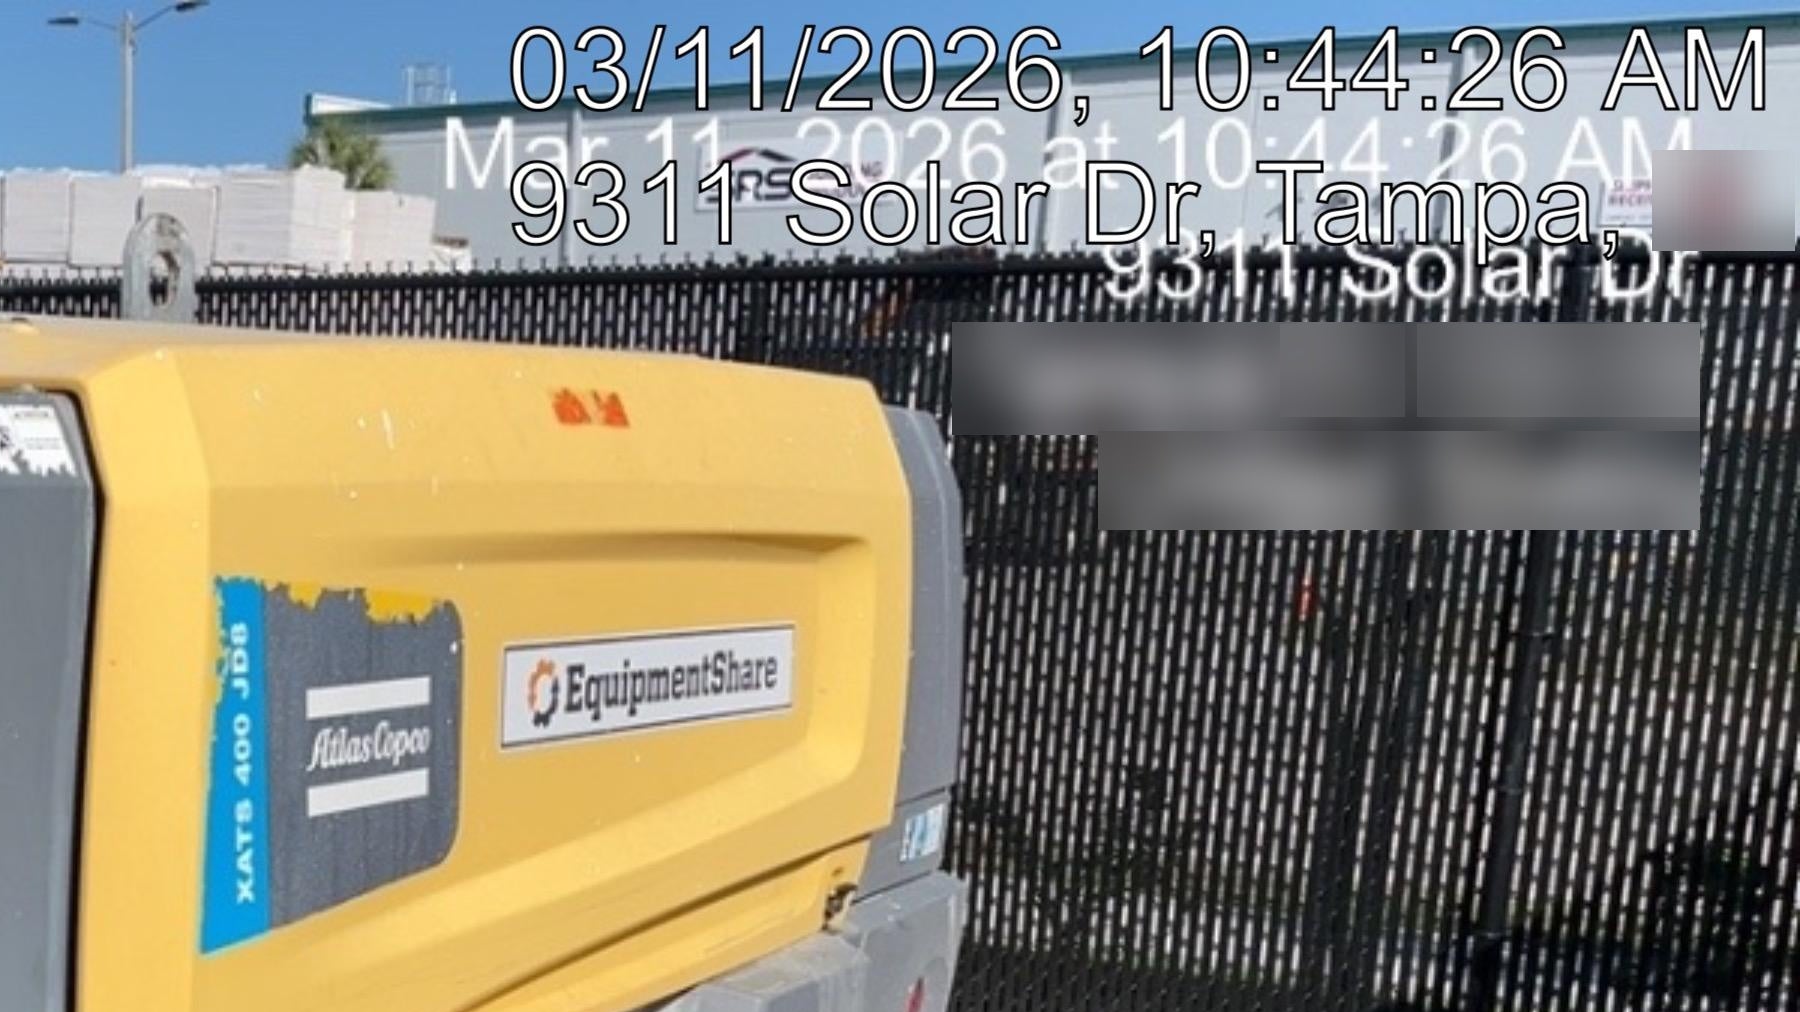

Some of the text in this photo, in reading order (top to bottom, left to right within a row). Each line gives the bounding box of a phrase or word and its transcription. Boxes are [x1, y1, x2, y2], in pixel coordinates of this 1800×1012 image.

[563, 650, 778, 716] EquipmentShare
[230, 622, 255, 904] XATS 400 JD8
[307, 720, 431, 772] Atlas Copco
